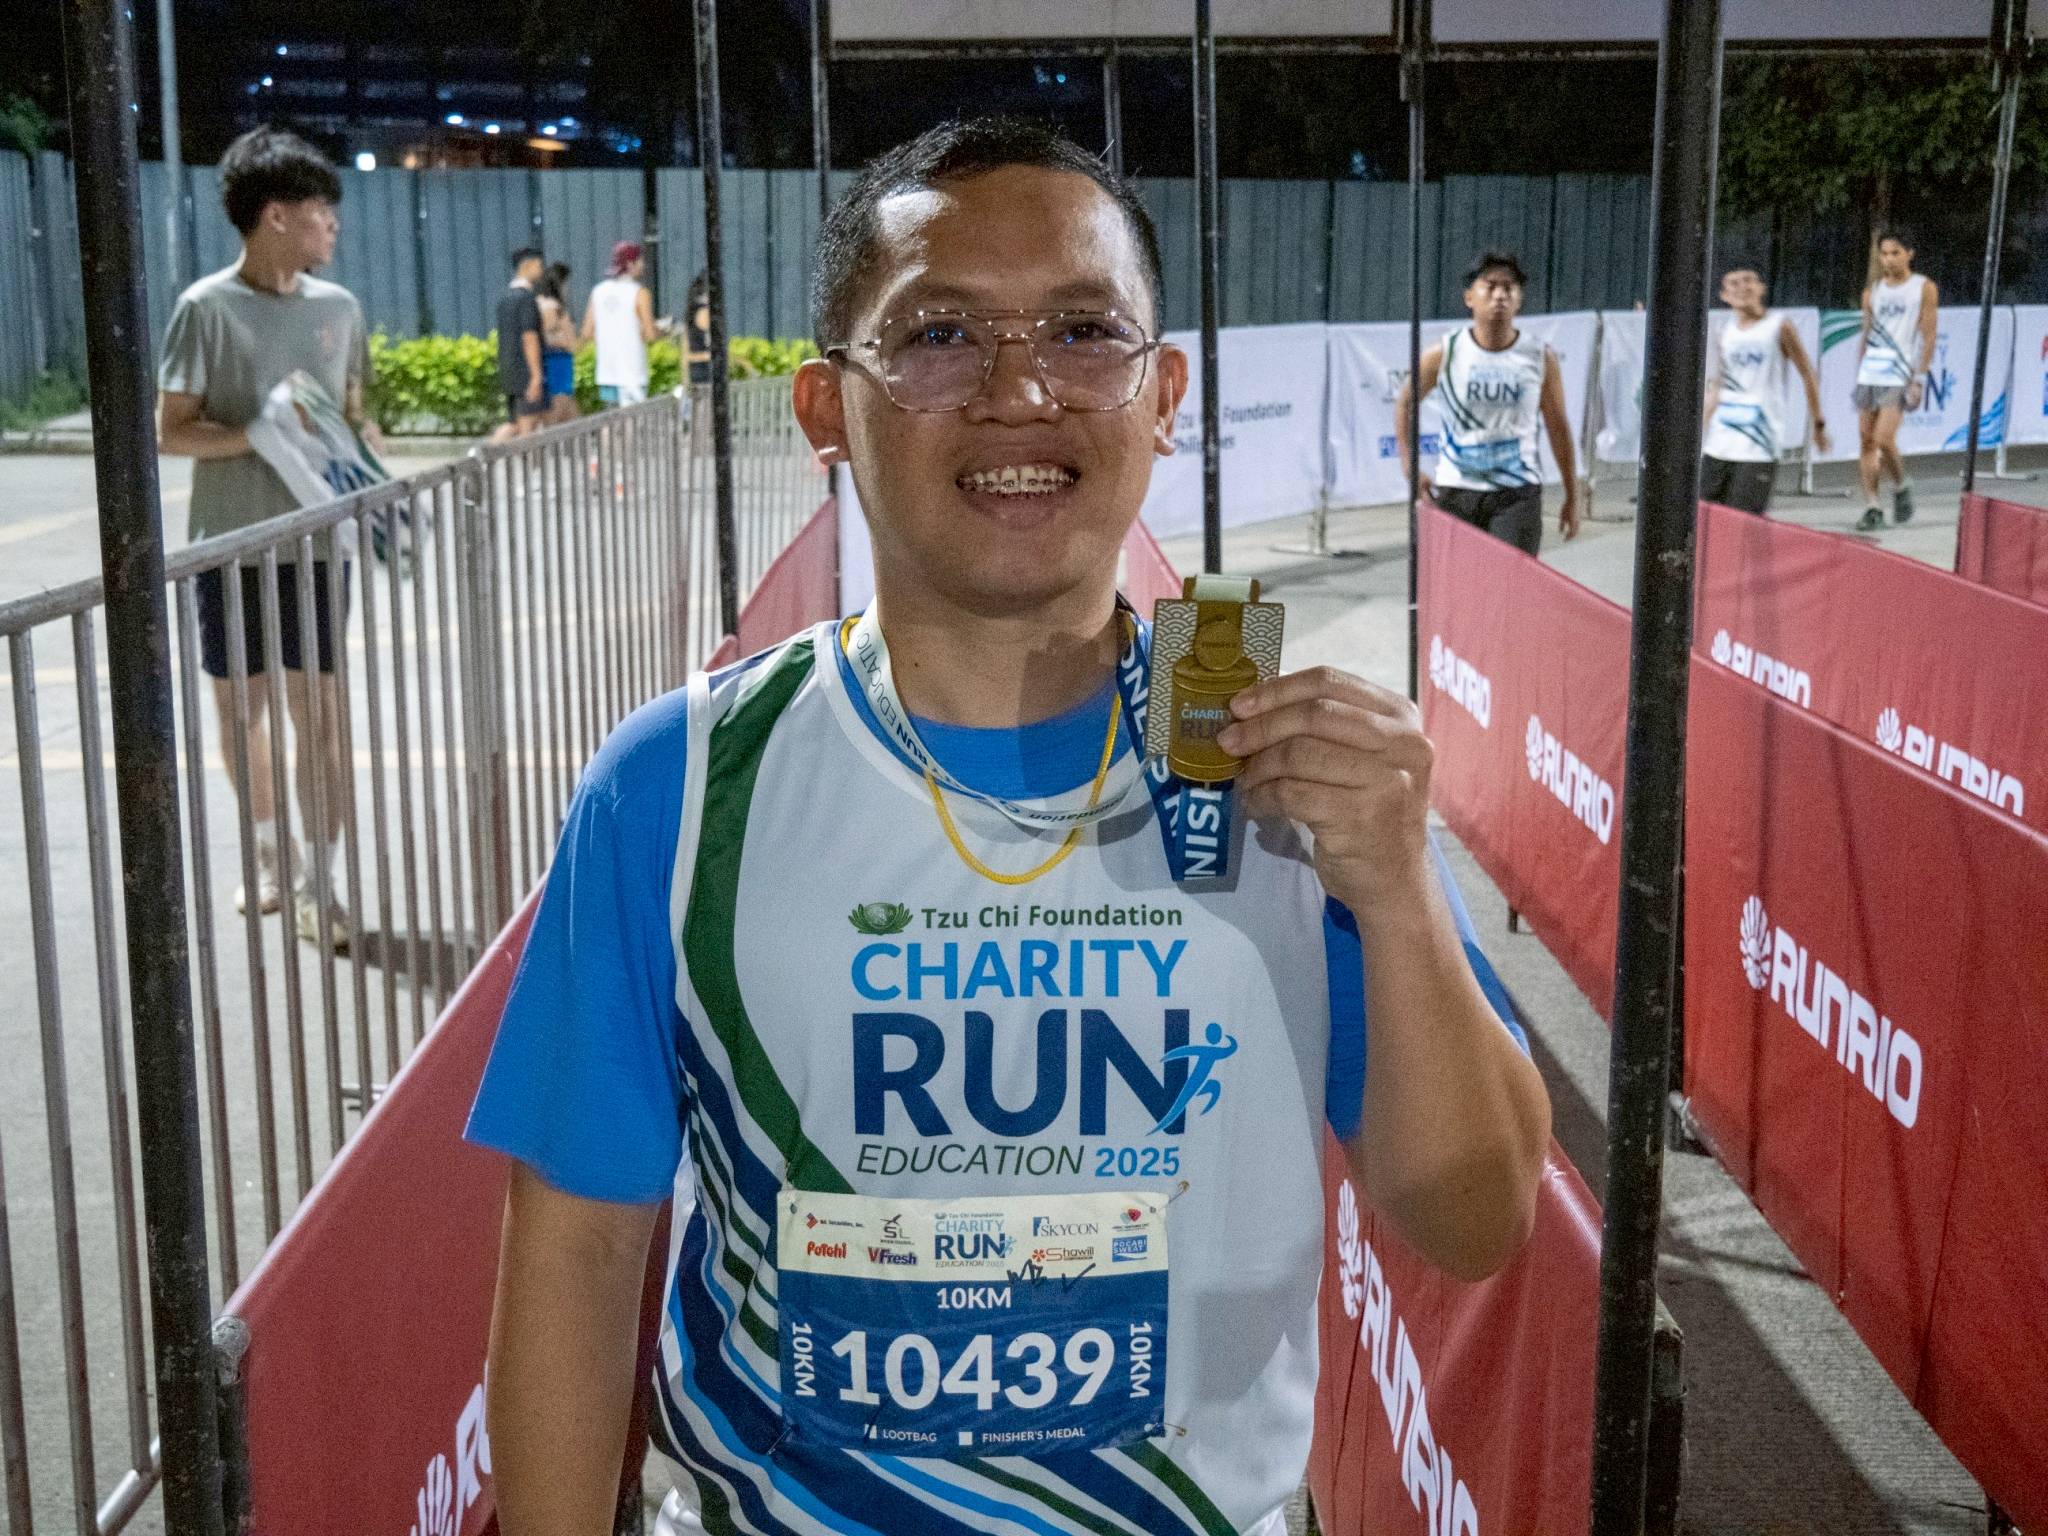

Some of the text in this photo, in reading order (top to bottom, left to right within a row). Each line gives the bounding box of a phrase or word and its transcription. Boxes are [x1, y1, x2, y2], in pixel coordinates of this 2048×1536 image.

[1467, 380, 1521, 402] RUN
[1444, 646, 1491, 730] RUNRIO
[1182, 708, 1231, 720] CHARIT
[1541, 732, 1614, 845] RUNRIO
[922, 903, 1183, 929] Tzu Chi Foundation
[851, 939, 1188, 1000] CHARITY
[1772, 926, 1923, 1129] RUNRIO
[852, 1008, 1191, 1138] RUN
[856, 1143, 1181, 1178] EDUCATION 2025
[935, 1219, 1005, 1233] CHARITY
[1041, 1222, 1099, 1237] SKYCON
[935, 1232, 1006, 1260] RUN
[1045, 1246, 1094, 1261] Shawill
[1113, 1238, 1146, 1248] POCARI
[1113, 1246, 1142, 1254] SWEAT
[935, 1260, 984, 1269] EDUCATION
[936, 1286, 1012, 1311] 10KM
[790, 1322, 817, 1398] 10KM
[831, 1328, 1116, 1411] 10439
[1129, 1321, 1153, 1399] 10KM
[882, 1428, 938, 1443] LOOTBAG
[982, 1427, 1087, 1443] FINISHER'S MEDAL
